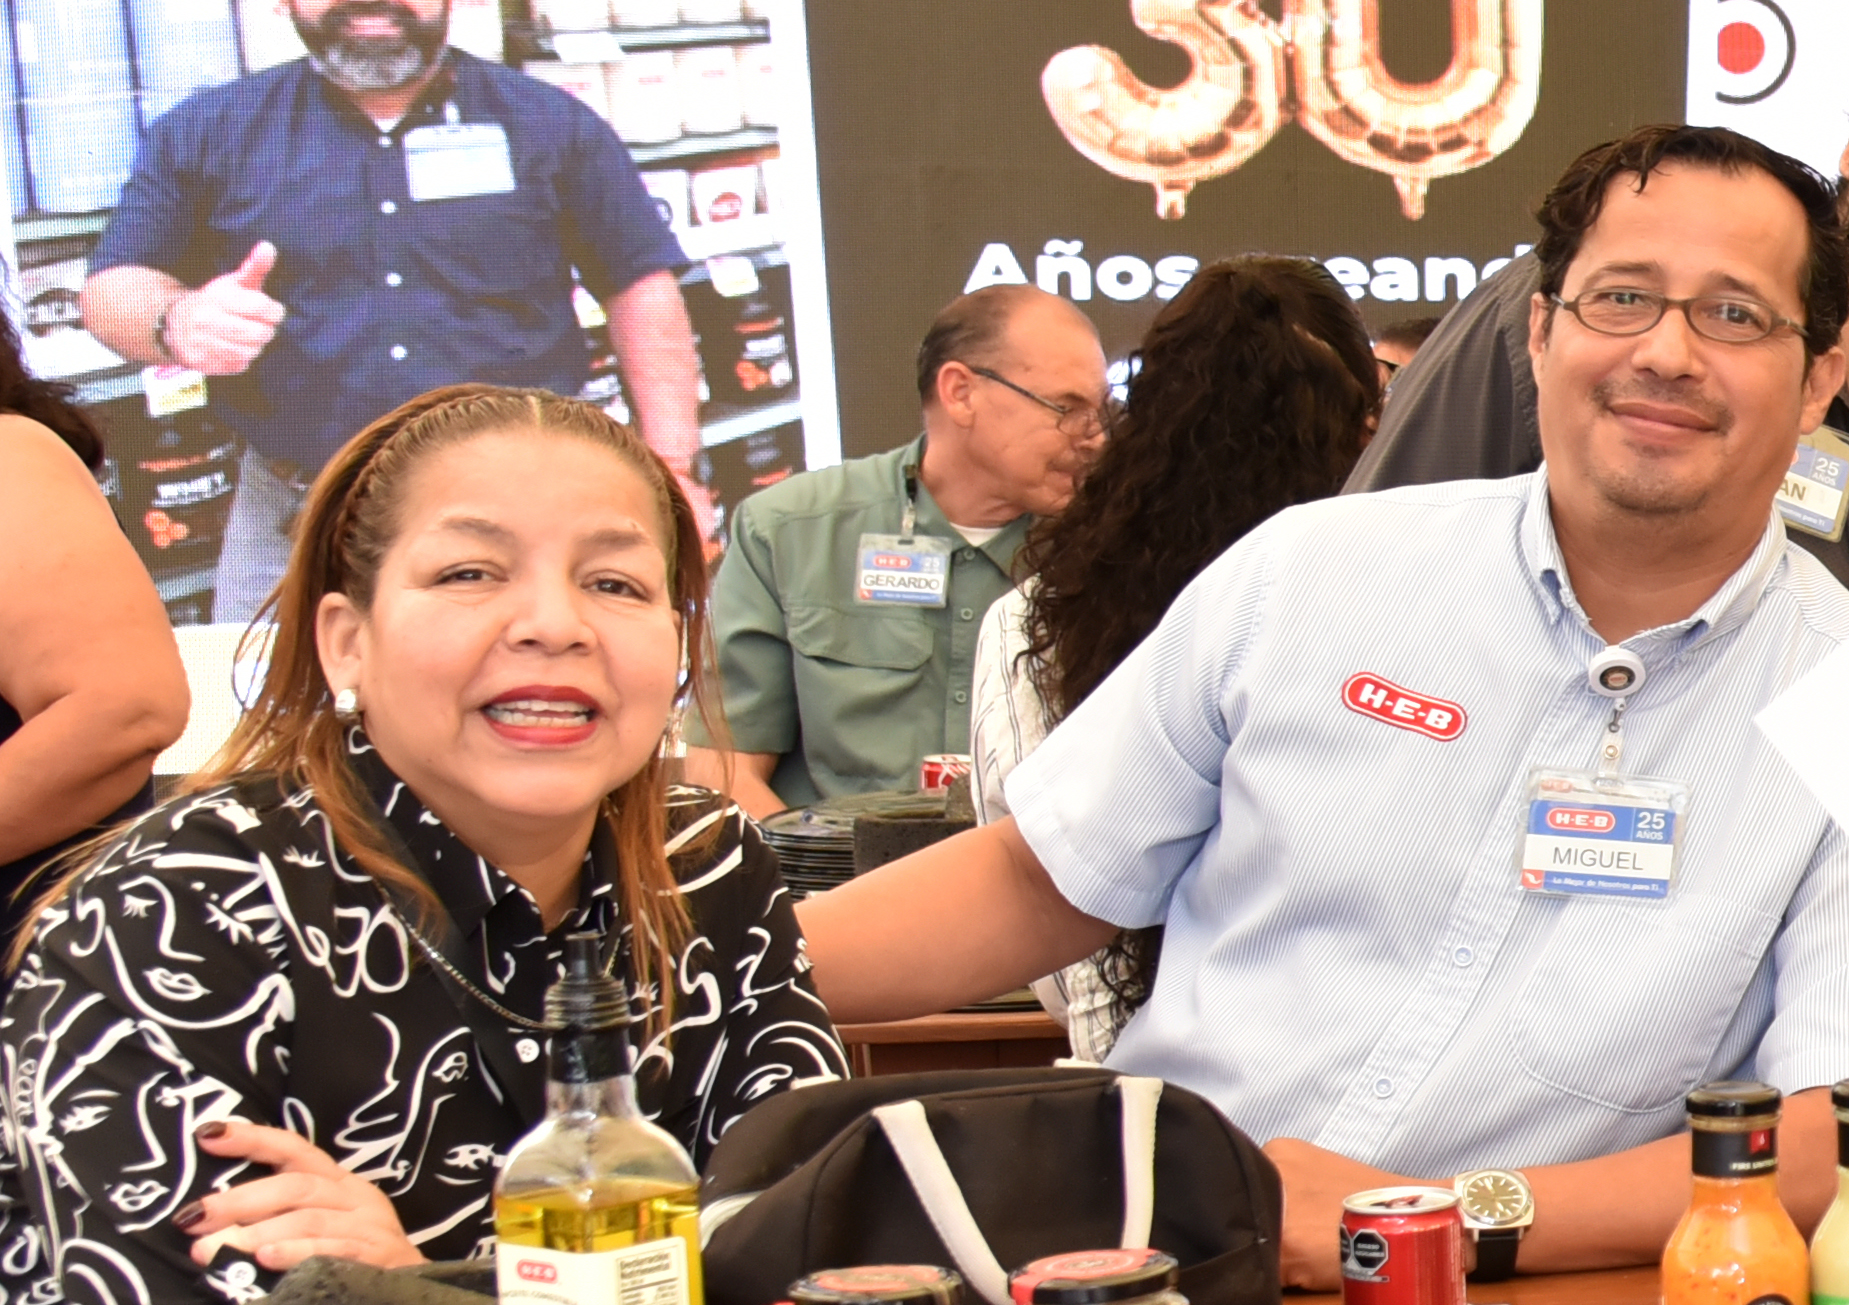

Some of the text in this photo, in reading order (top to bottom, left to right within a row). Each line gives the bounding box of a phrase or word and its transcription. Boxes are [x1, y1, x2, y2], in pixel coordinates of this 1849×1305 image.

[1815, 457, 1839, 476] 25
[1780, 478, 1807, 500] AN
[864, 574, 940, 590] GERARDO
[1637, 811, 1665, 829] 25
[1636, 830, 1664, 840] AÑOS
[1552, 847, 1643, 870] MIGUEL
